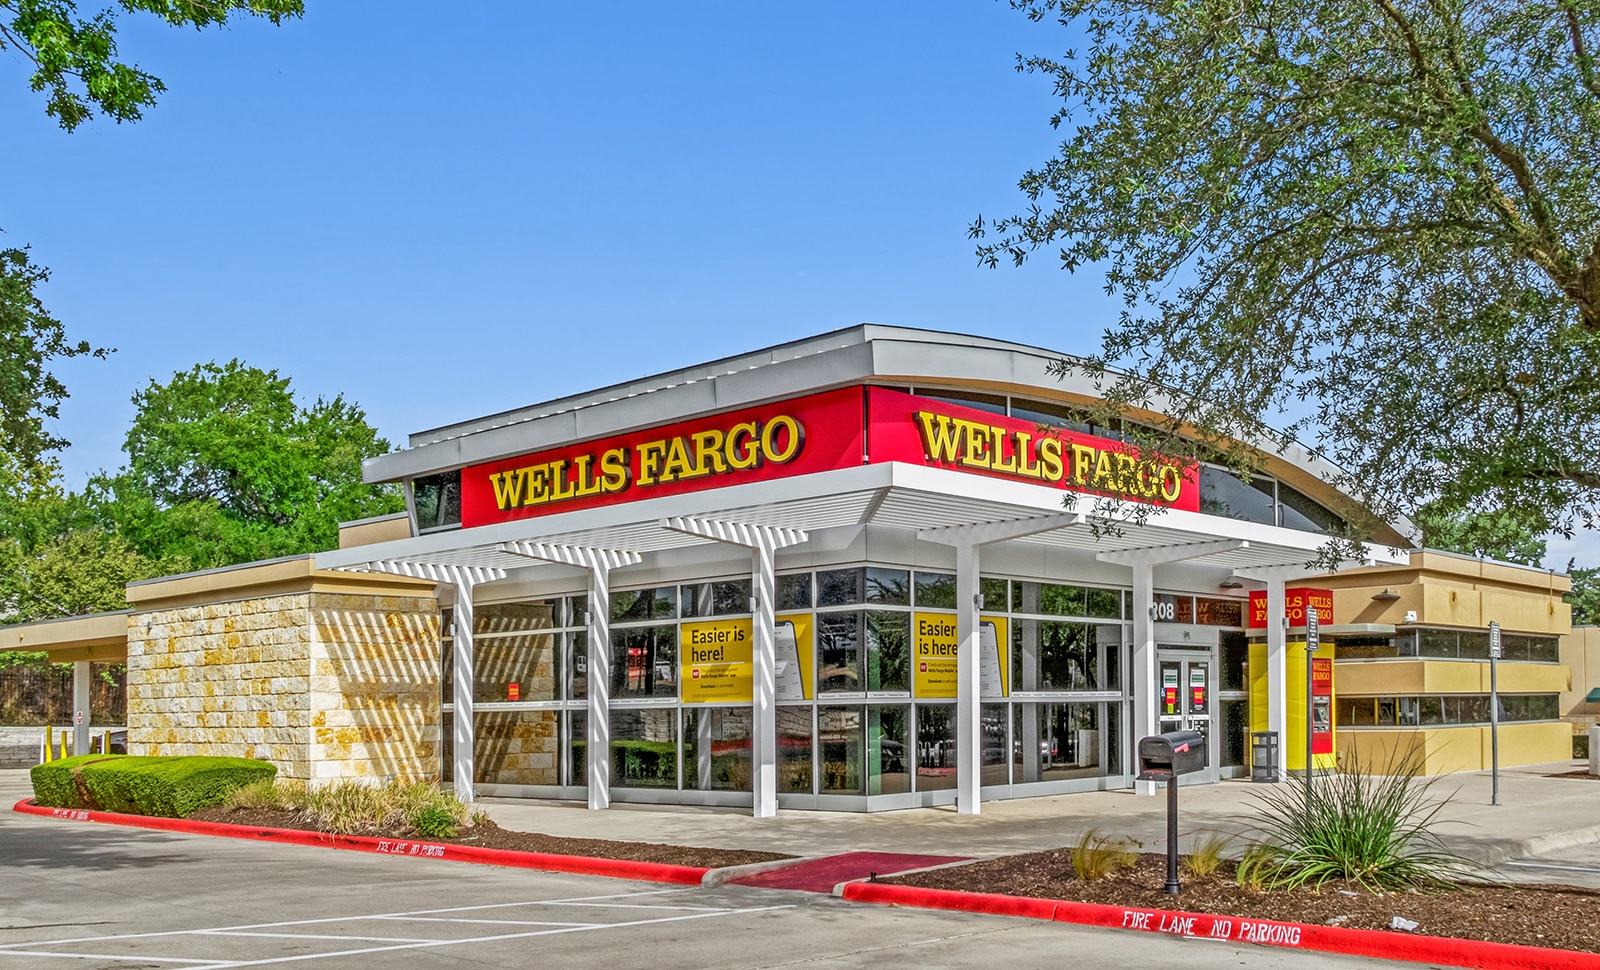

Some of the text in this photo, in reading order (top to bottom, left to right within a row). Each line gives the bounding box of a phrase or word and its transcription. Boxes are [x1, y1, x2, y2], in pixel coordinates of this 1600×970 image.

[489, 414, 803, 511] WELLS FARGO
[917, 410, 1182, 502] WELLS FARGO
[1253, 596, 1303, 609] WLS
[1308, 596, 1332, 608] WELLS
[691, 625, 745, 644] Easier is
[919, 620, 956, 637] Easier
[691, 645, 724, 662] here!
[919, 638, 958, 656] is here
[1121, 910, 1301, 945] FIRE LANE NO PARKING
